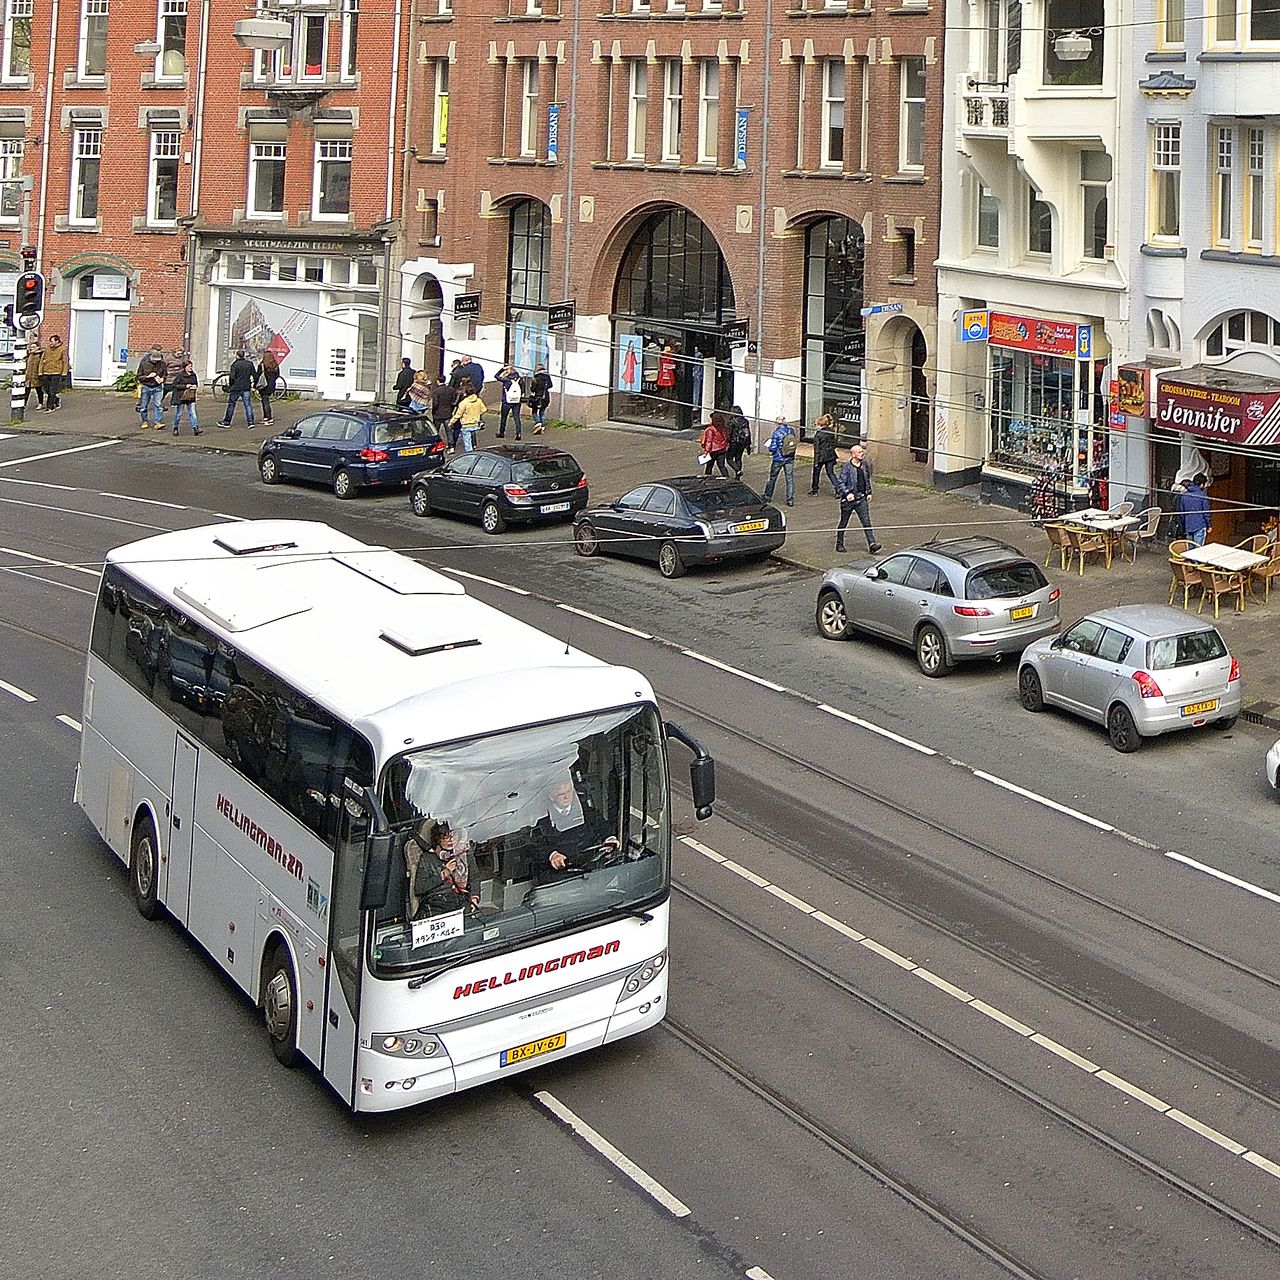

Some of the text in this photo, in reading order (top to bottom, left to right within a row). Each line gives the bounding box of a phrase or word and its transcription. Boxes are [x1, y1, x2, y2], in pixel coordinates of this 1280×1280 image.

[549, 112, 558, 146] DESAN
[738, 117, 747, 153] DESAN
[217, 239, 231, 247] 52
[456, 302, 477, 310] LABELS
[550, 311, 571, 319] LABELS
[1160, 384, 1208, 400] CROISSANTERIE
[1210, 393, 1241, 406] TEAROOM
[1160, 398, 1241, 435] Jennifer
[511, 1036, 562, 1060] BX-JV-67
